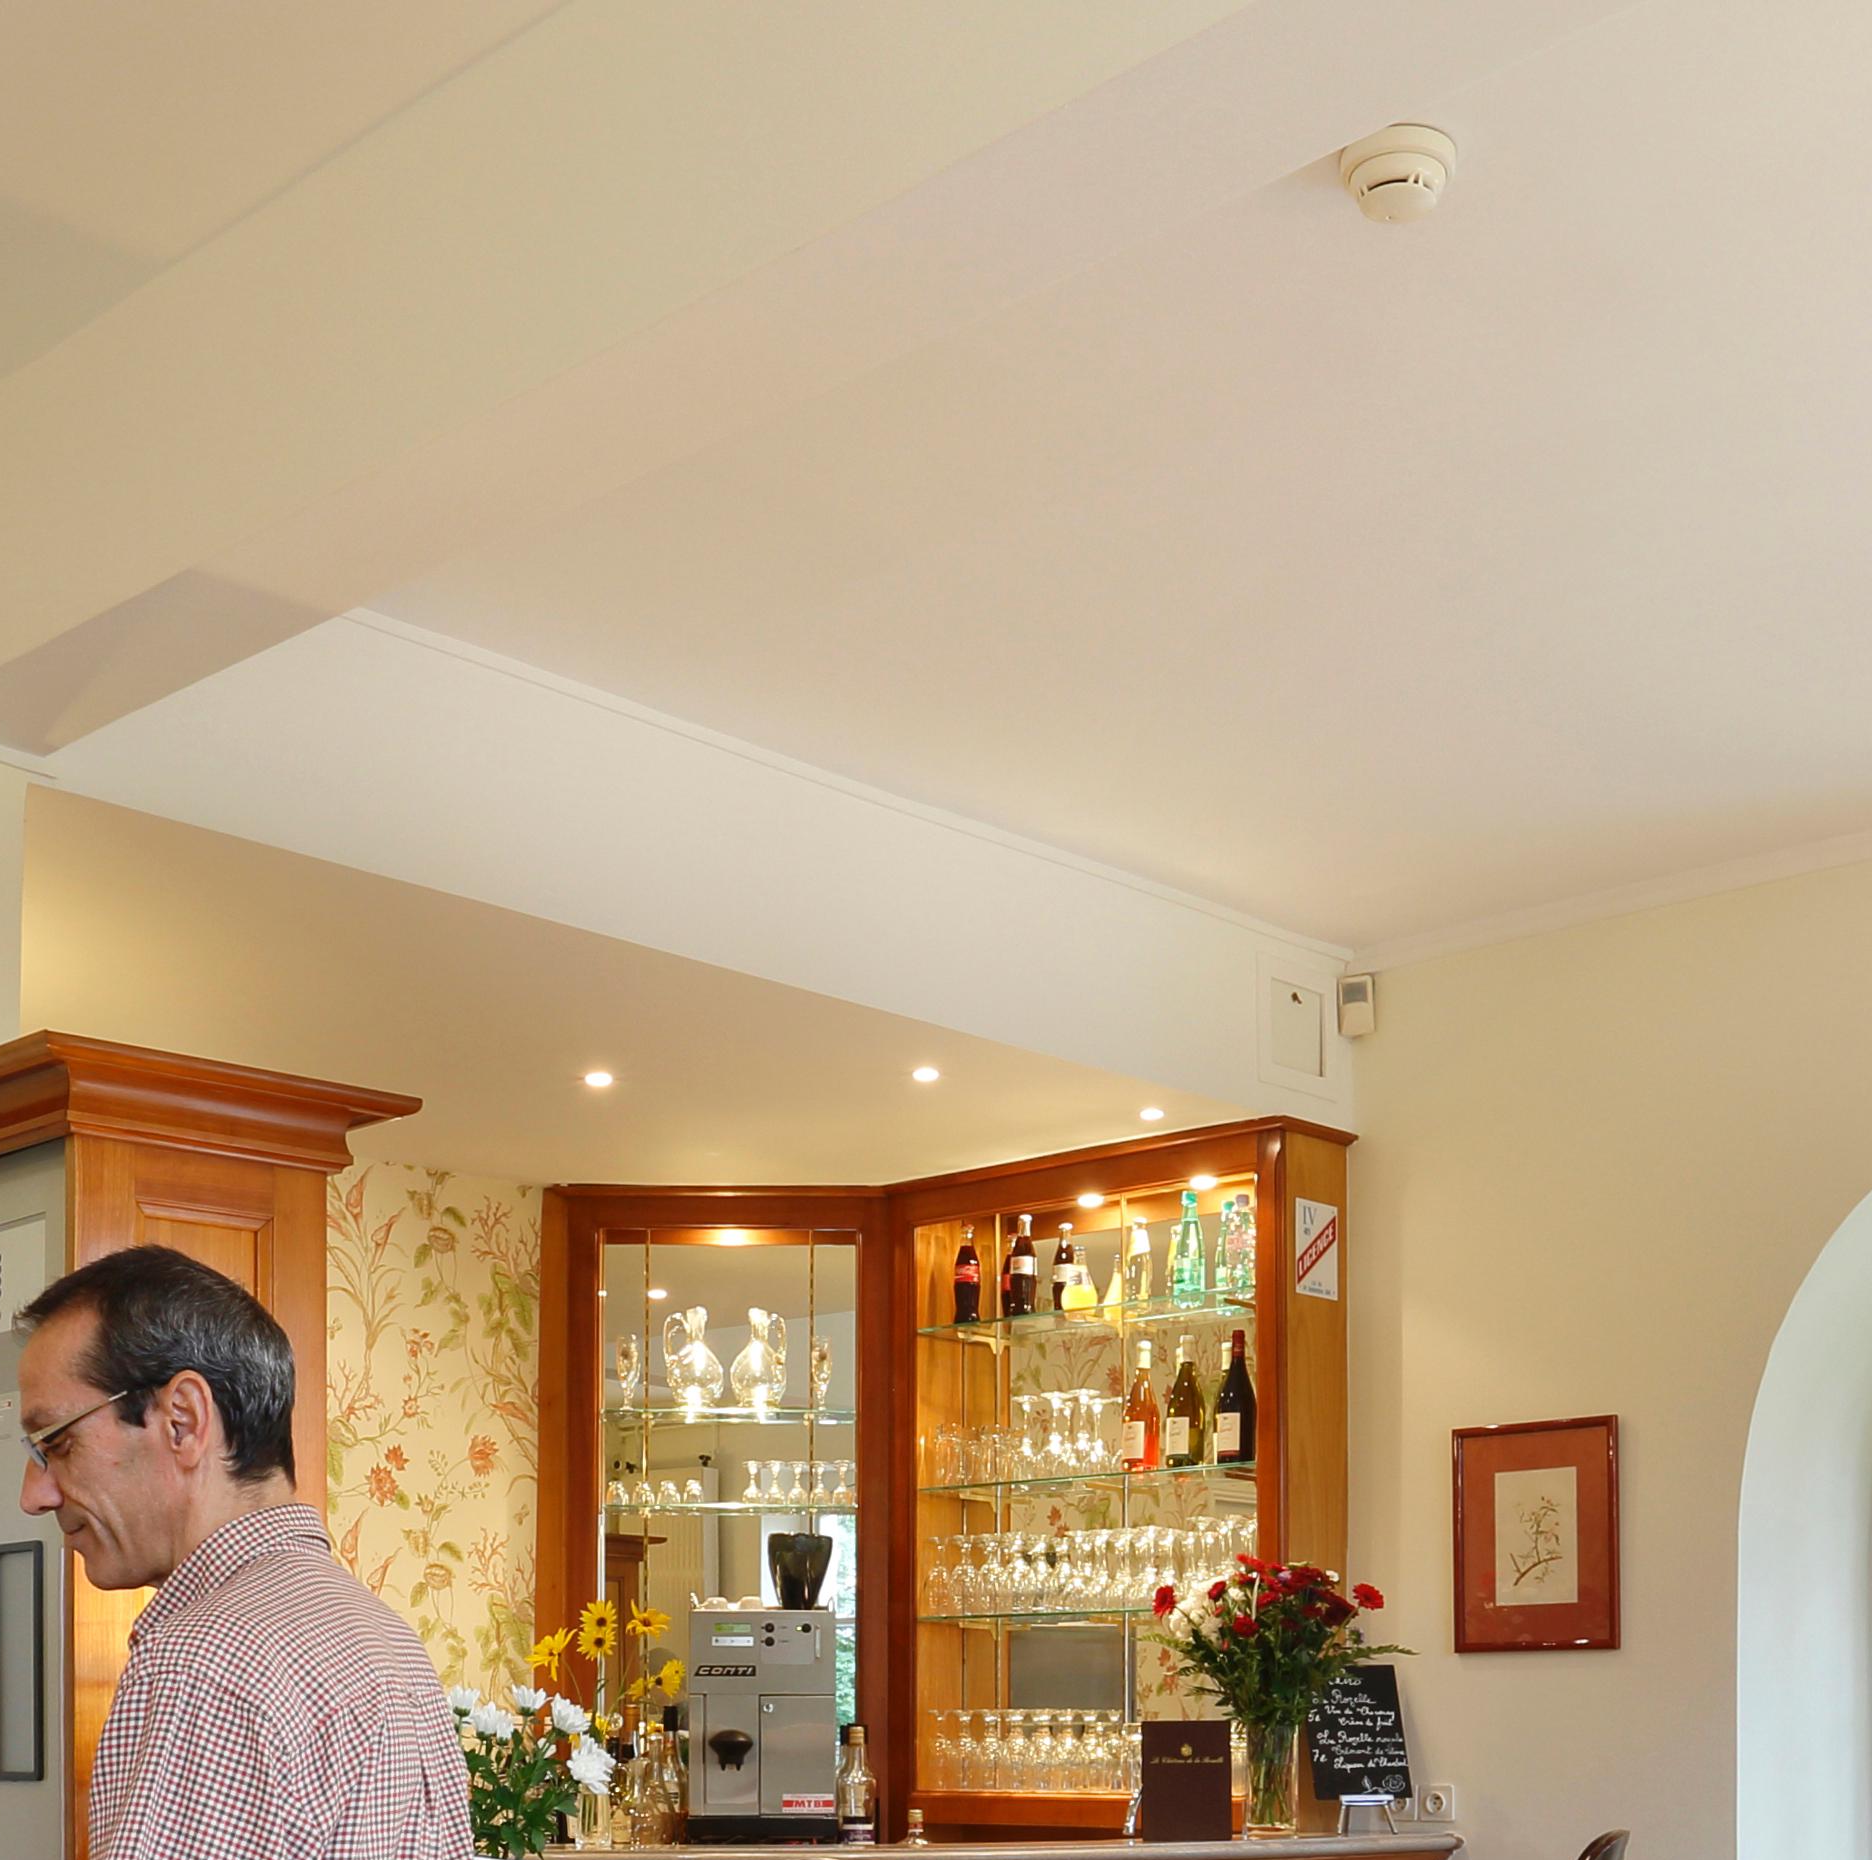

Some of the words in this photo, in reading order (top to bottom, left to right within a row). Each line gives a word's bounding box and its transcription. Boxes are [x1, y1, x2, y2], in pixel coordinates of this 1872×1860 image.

[1302, 1205, 1317, 1225] IV
[1298, 1221, 1335, 1278] LICENCE
[698, 1667, 754, 1675] CONTI
